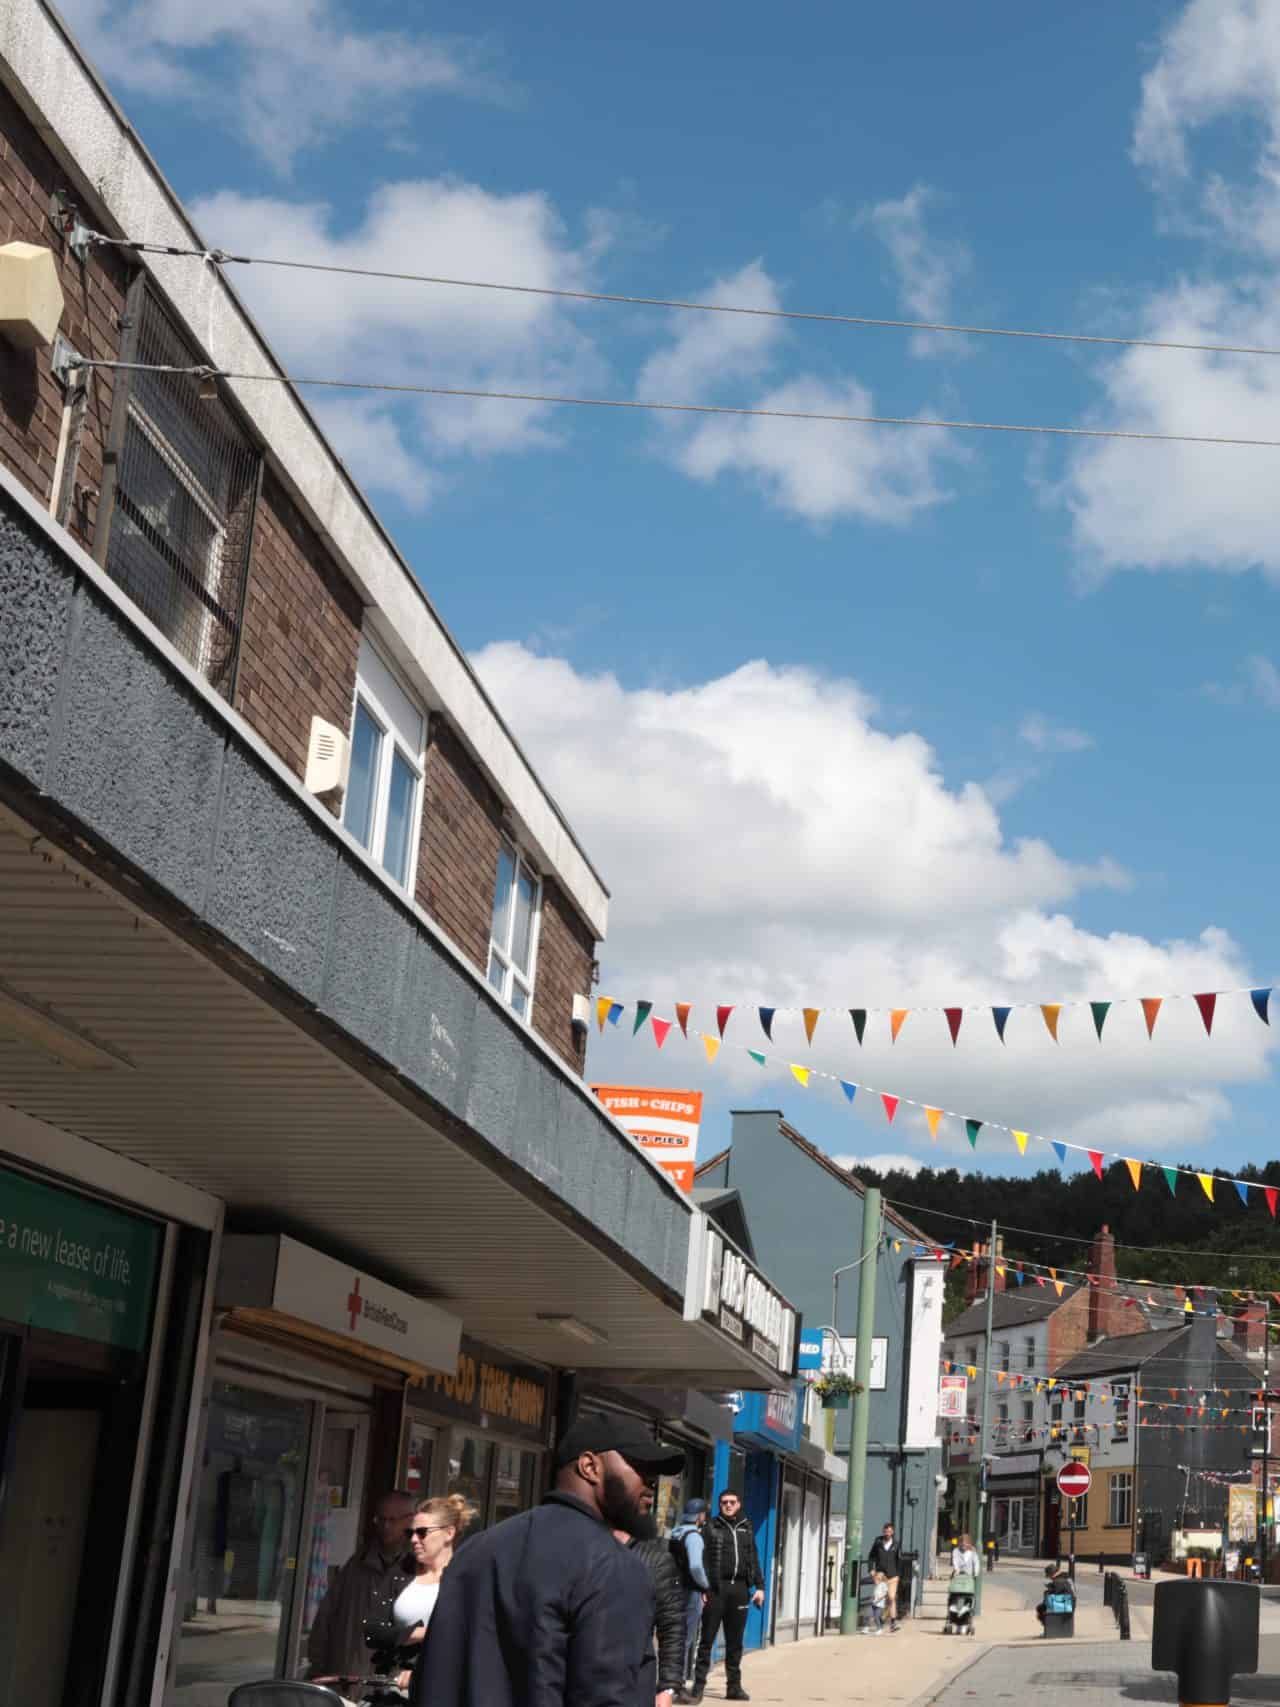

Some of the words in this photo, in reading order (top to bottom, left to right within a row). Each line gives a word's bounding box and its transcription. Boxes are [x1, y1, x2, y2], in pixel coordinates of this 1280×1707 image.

[605, 1097, 640, 1109] FISH
[650, 1098, 695, 1116] CHIPS
[8, 1223, 18, 1249] a
[22, 1227, 51, 1260] new
[55, 1228, 90, 1272] lease
[94, 1244, 111, 1278] of
